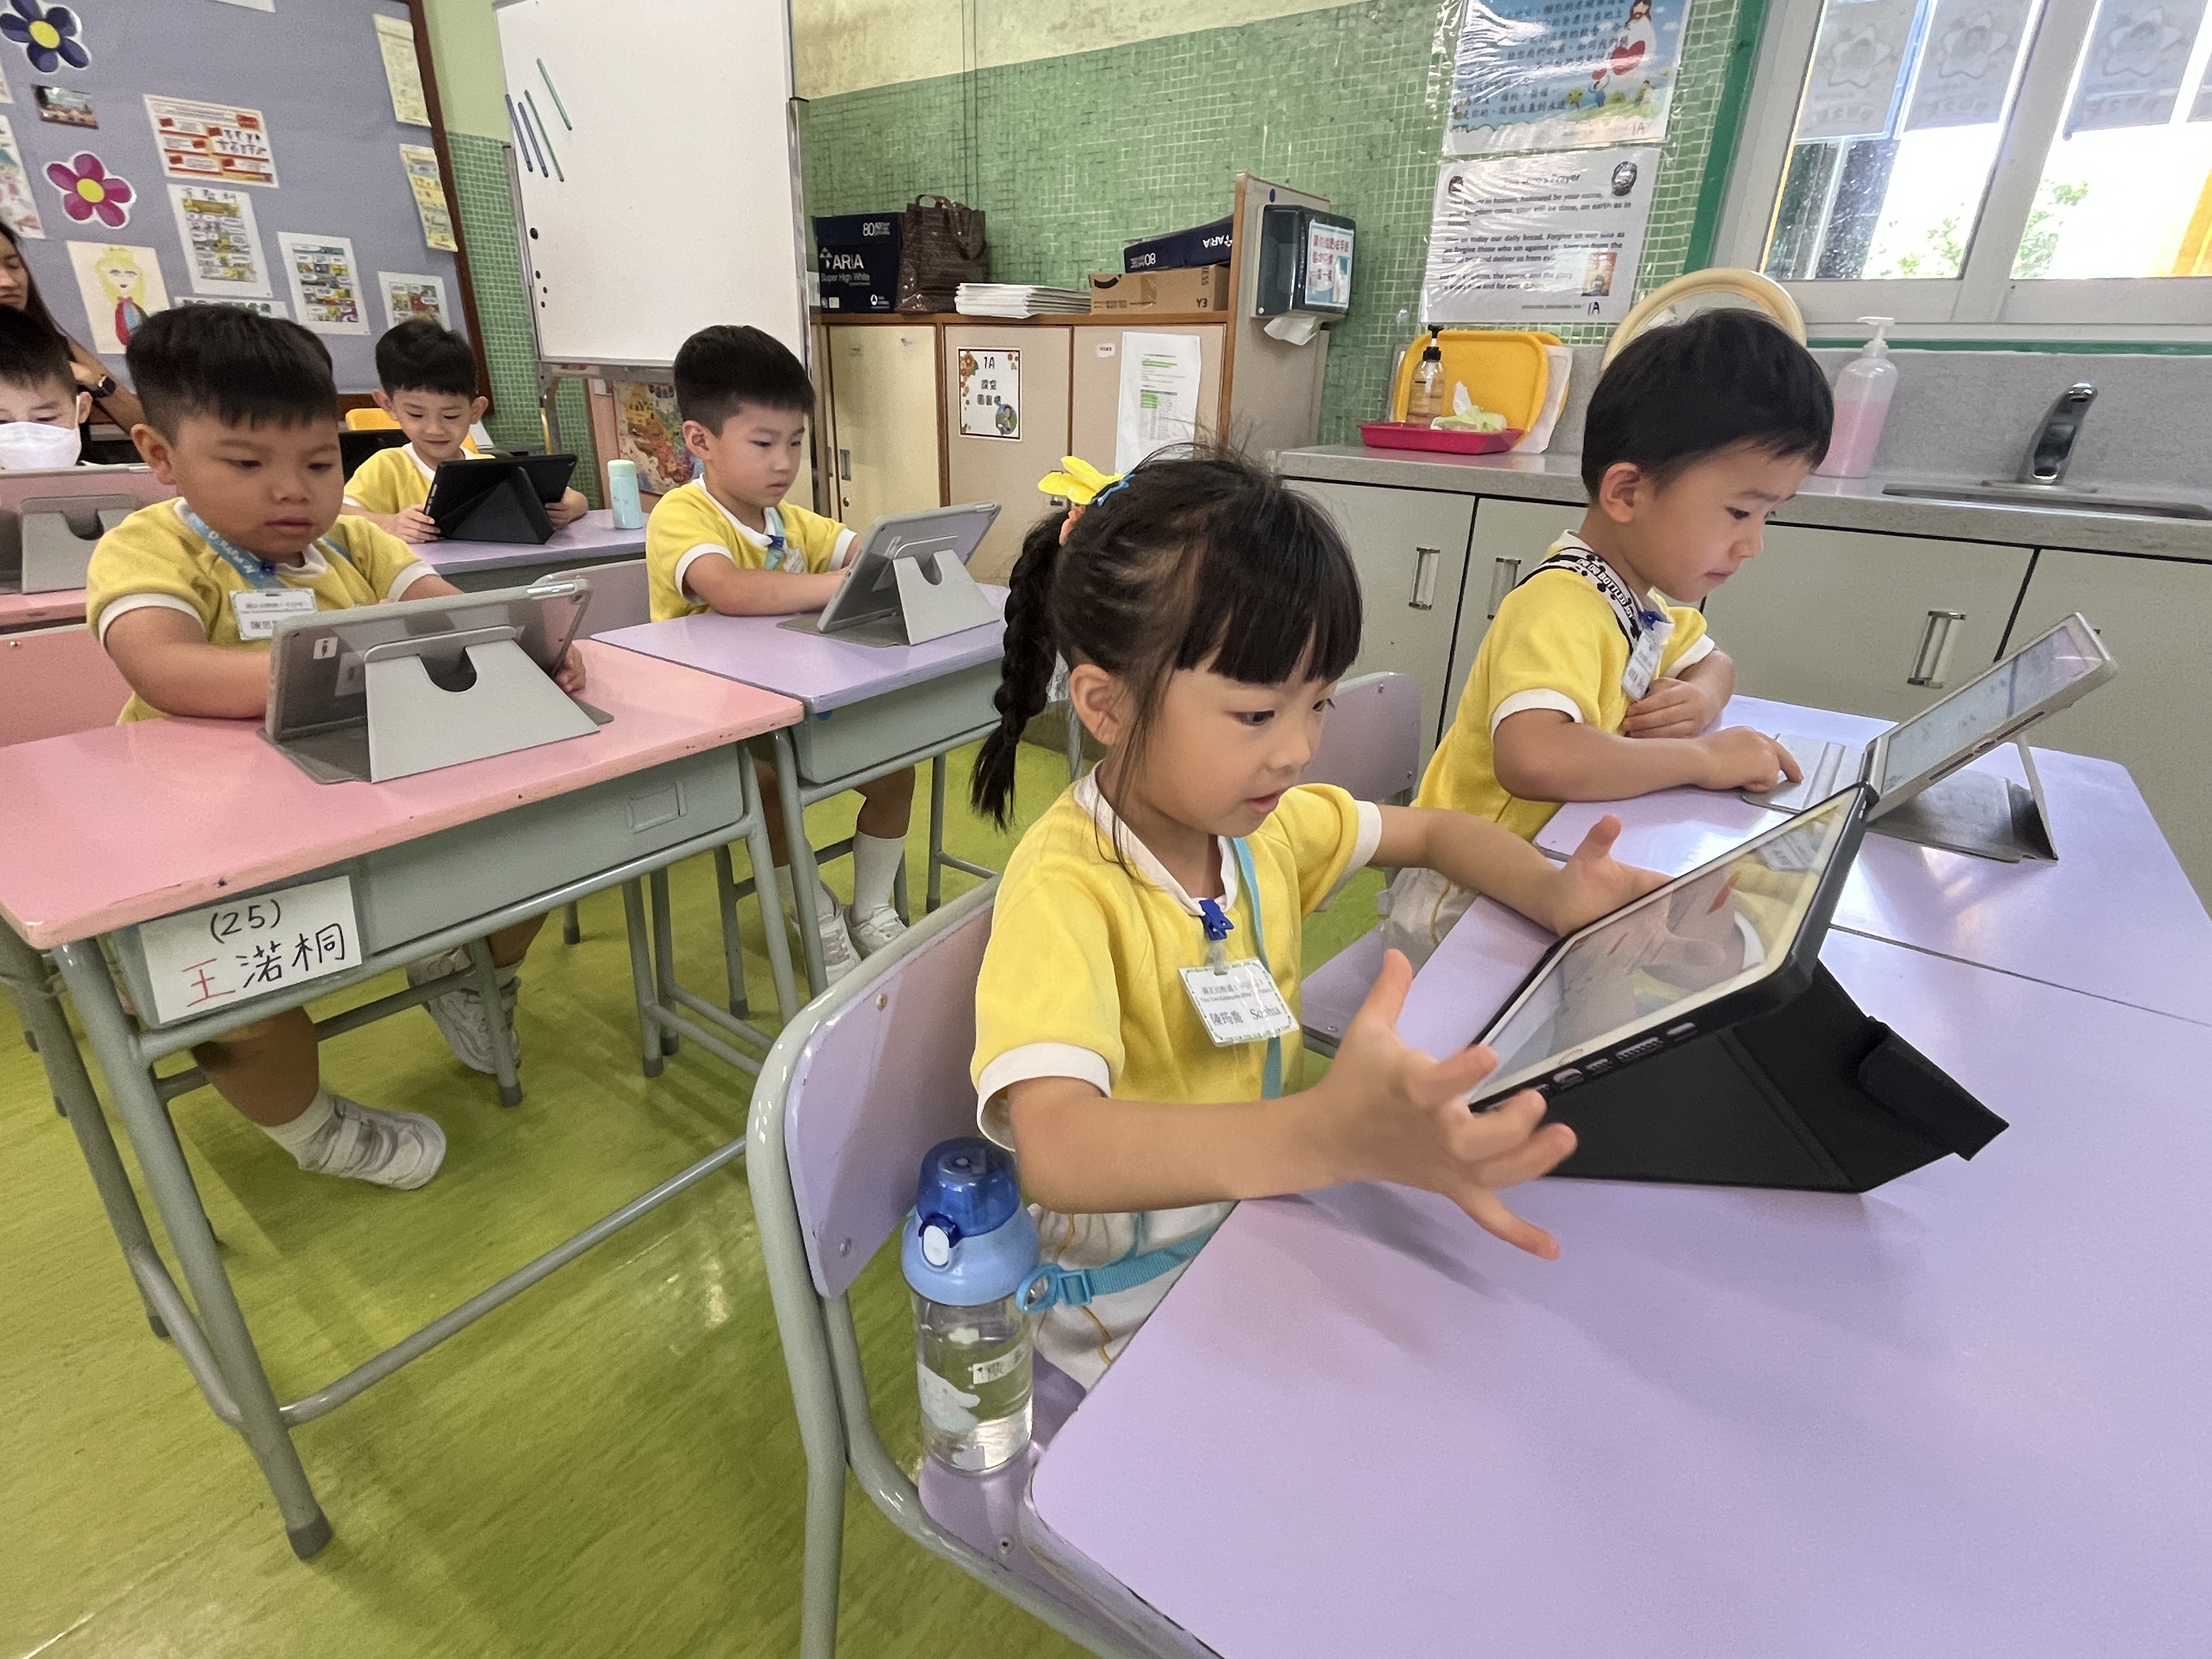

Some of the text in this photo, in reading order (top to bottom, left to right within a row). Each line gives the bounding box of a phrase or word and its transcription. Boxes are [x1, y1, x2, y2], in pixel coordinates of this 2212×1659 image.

[863, 222, 875, 236] 80
[833, 253, 865, 269] ARIA
[1196, 298, 1208, 308] Y3
[1588, 302, 1600, 316] 1A
[984, 357, 995, 369] 1A
[210, 899, 281, 944] (25)
